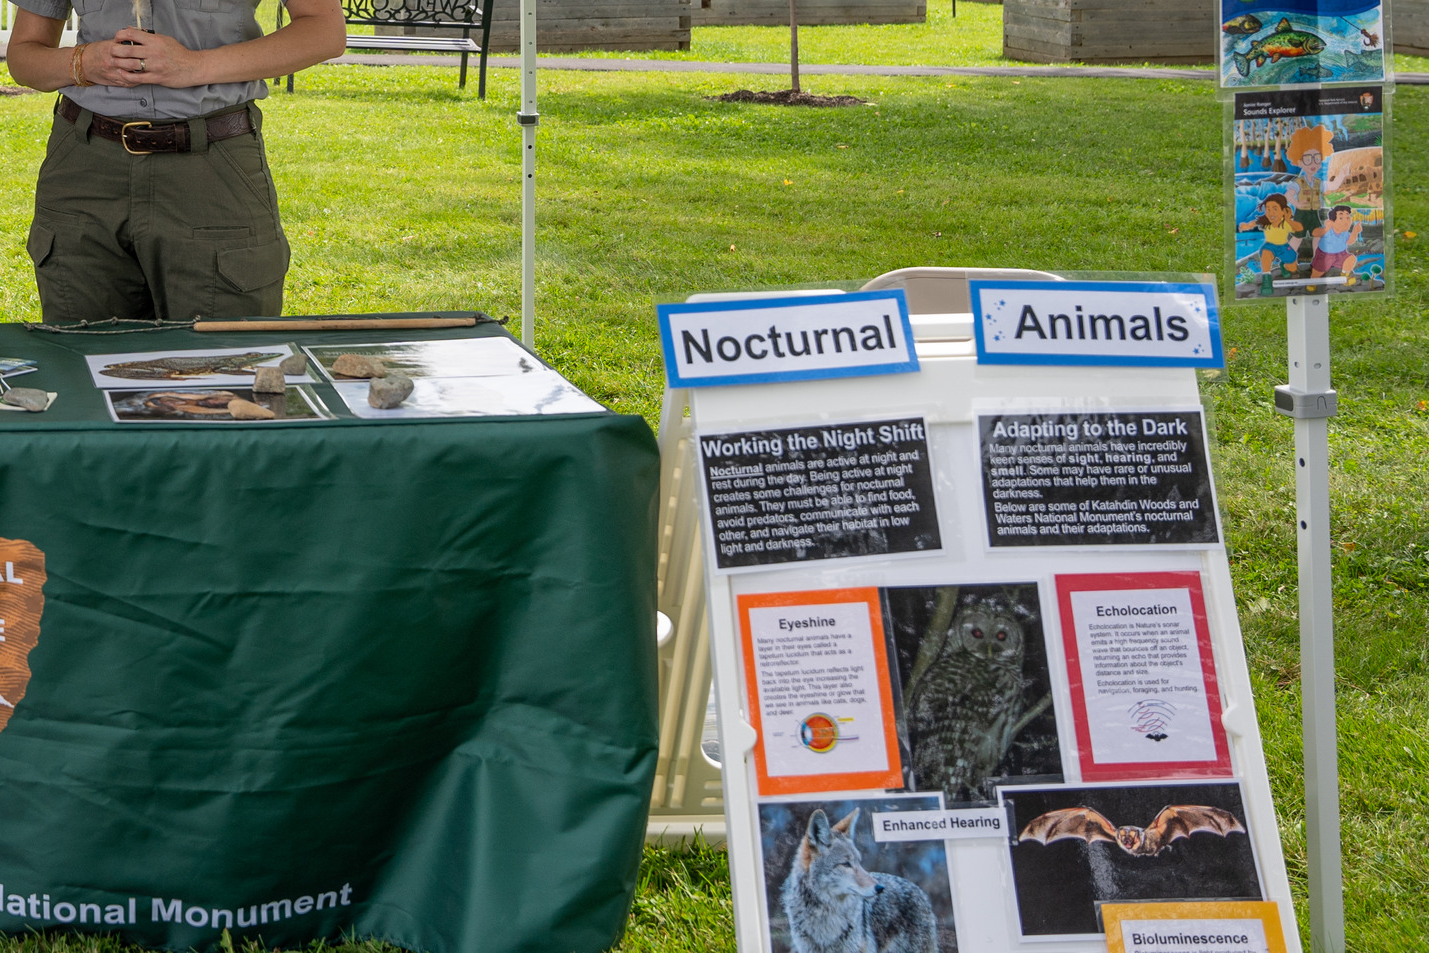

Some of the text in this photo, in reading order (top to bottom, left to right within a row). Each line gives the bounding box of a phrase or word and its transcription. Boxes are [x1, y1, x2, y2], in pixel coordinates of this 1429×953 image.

[1015, 304, 1190, 342] Animals
[680, 314, 898, 365] Nocturnal
[702, 424, 924, 458] Working the Night Shift
[993, 418, 1188, 441] Adapting to the Dark
[710, 450, 920, 477] Nocturnal animals are active at night and
[712, 464, 913, 490] rest during the day. Being active at night
[714, 477, 905, 502] creates some challenges for nocturnal
[716, 489, 916, 516] animals. They must be able to find food,
[994, 499, 1200, 512] Below are some of Katahdin Woods and
[717, 502, 920, 529] avoid predators, communicate with each
[995, 510, 1193, 524] Waters National Monument's nocturnal
[719, 516, 910, 542] other, and navigate their habitat in low
[997, 523, 1150, 536] animals and their adaptations.
[720, 538, 814, 557] light and darkness.
[1096, 604, 1177, 617] Echolocation
[779, 617, 836, 631] Eyeshine
[883, 816, 1000, 832] Enhanced Hearing
[151, 882, 353, 928] Monument
[1132, 933, 1249, 945] Bioluminescence
